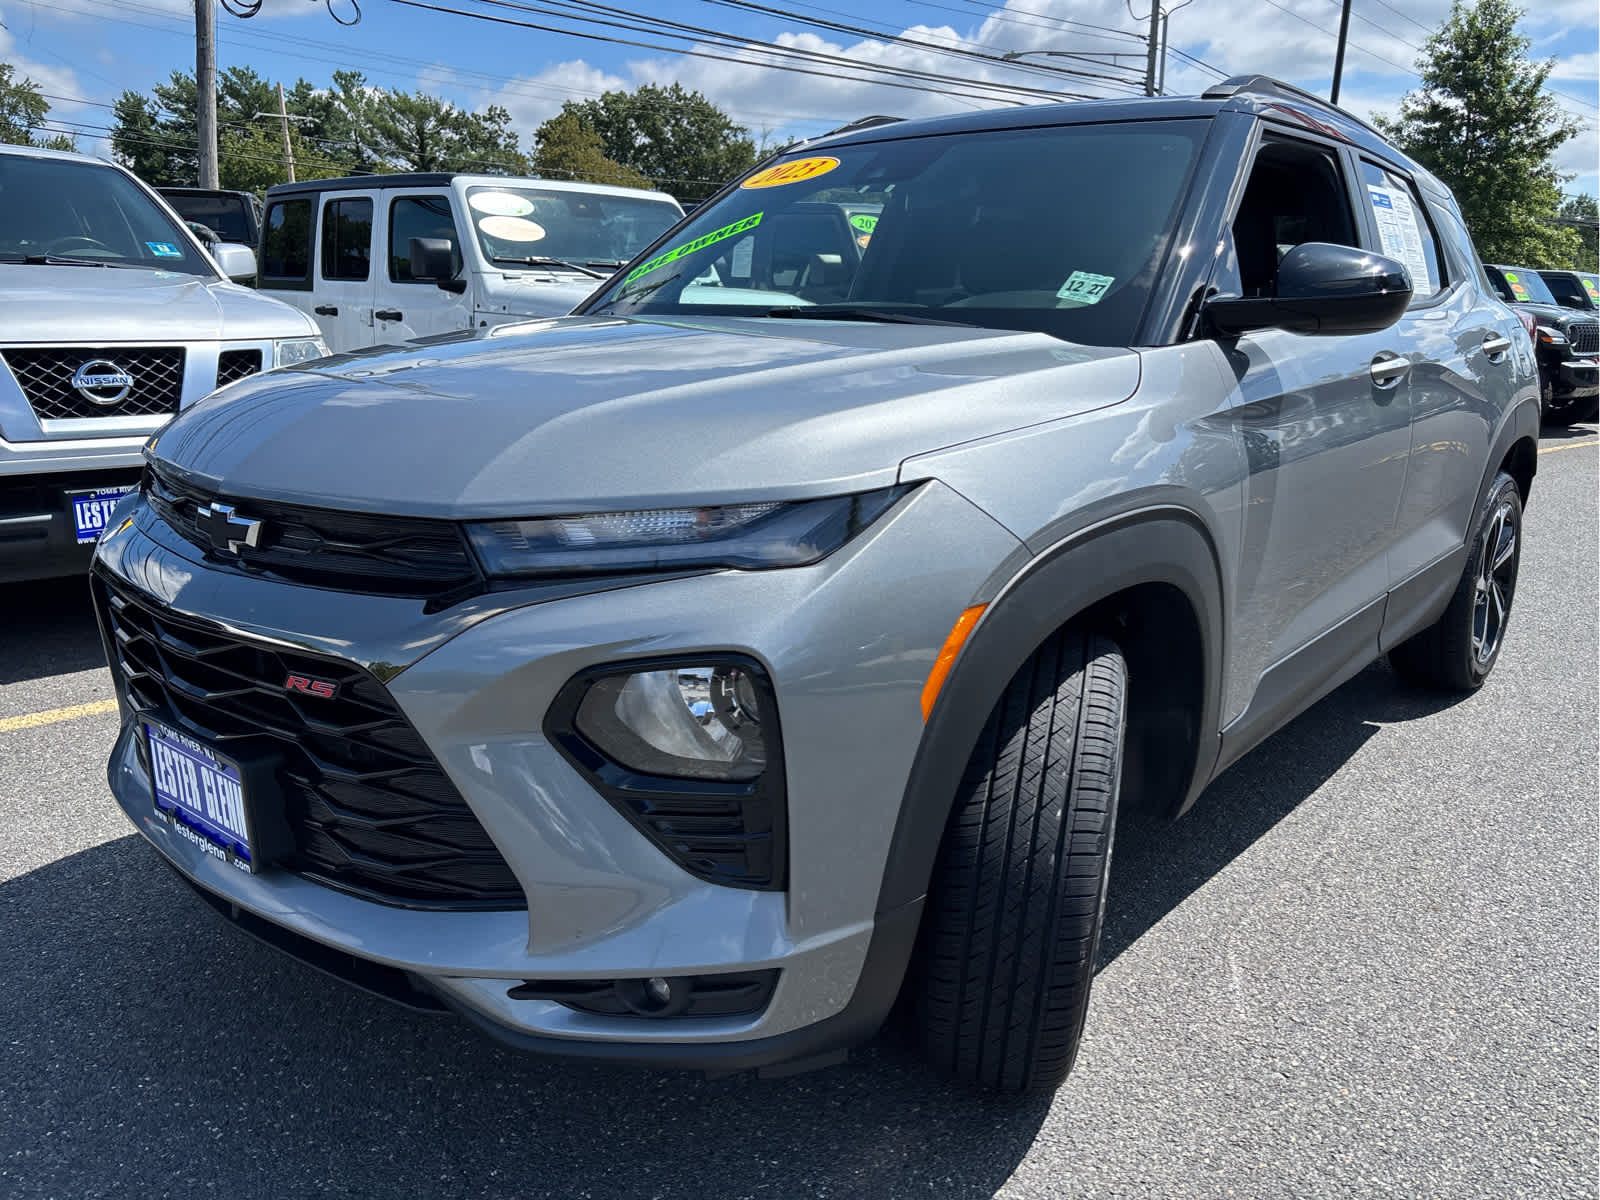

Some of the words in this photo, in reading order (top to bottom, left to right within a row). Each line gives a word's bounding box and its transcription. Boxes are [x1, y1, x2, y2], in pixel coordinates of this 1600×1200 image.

[750, 159, 828, 185] 2023
[628, 254, 675, 280] ONE
[676, 215, 758, 257] OWNER
[1065, 280, 1085, 292] 12
[1086, 283, 1107, 296] 27
[80, 377, 129, 385] NISSAN
[286, 675, 337, 698] RS
[159, 725, 181, 743] TOMS
[150, 738, 202, 812] LESTER
[201, 765, 249, 842] GLENN
[172, 820, 227, 862] lesterglenn
